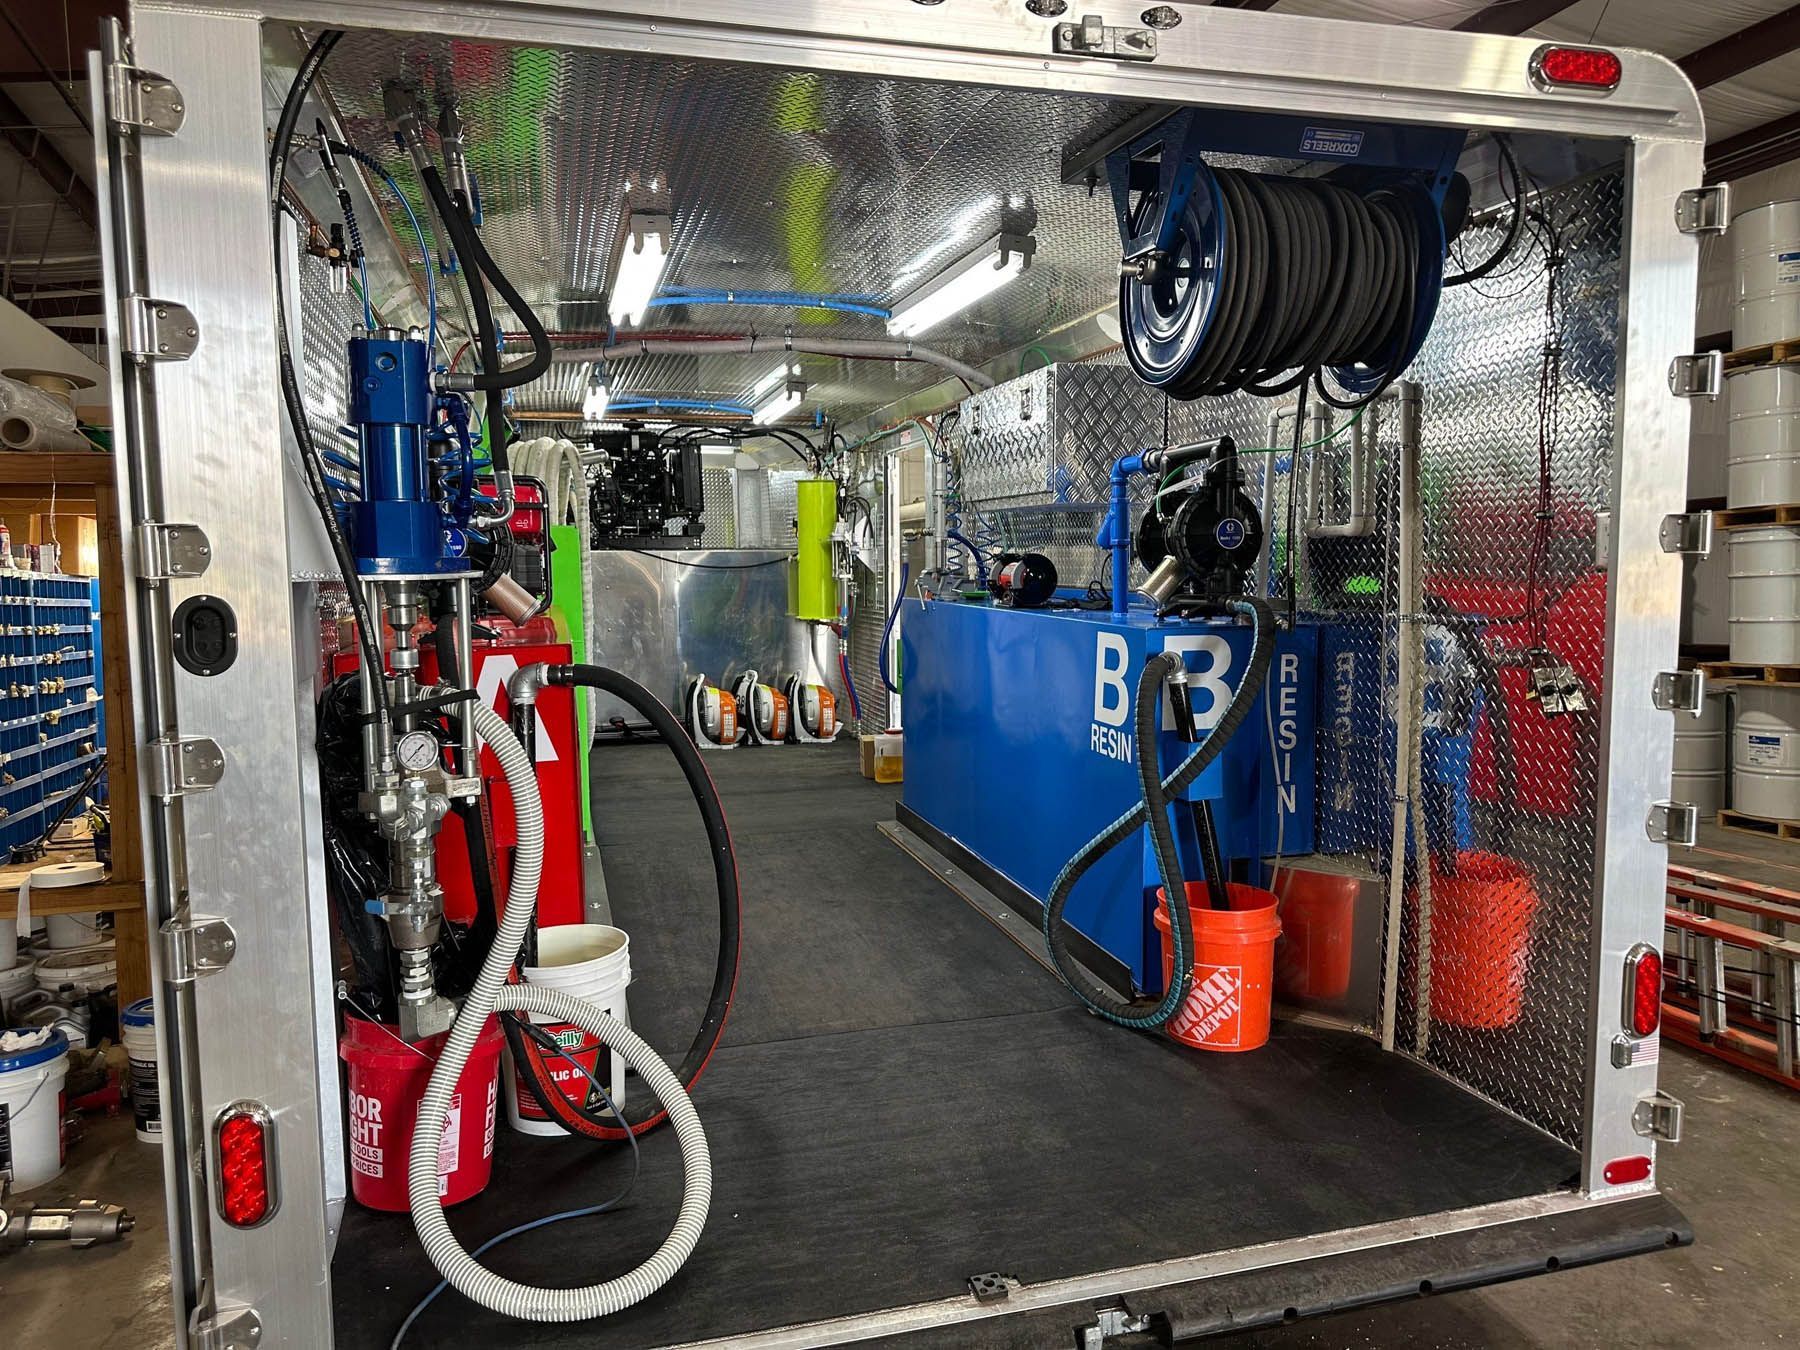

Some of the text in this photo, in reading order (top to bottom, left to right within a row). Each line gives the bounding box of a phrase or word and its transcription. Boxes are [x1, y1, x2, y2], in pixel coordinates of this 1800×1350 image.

[1303, 139, 1358, 154] COXREELS
[1093, 631, 1130, 727] B
[1161, 634, 1233, 732] B
[452, 654, 560, 763] A
[1090, 722, 1132, 764] RESIN
[1278, 653, 1299, 814] RESIN
[1190, 995, 1240, 1041] DEPOT
[352, 1157, 379, 1176] PRICES
[353, 1144, 379, 1160] TOOLS
